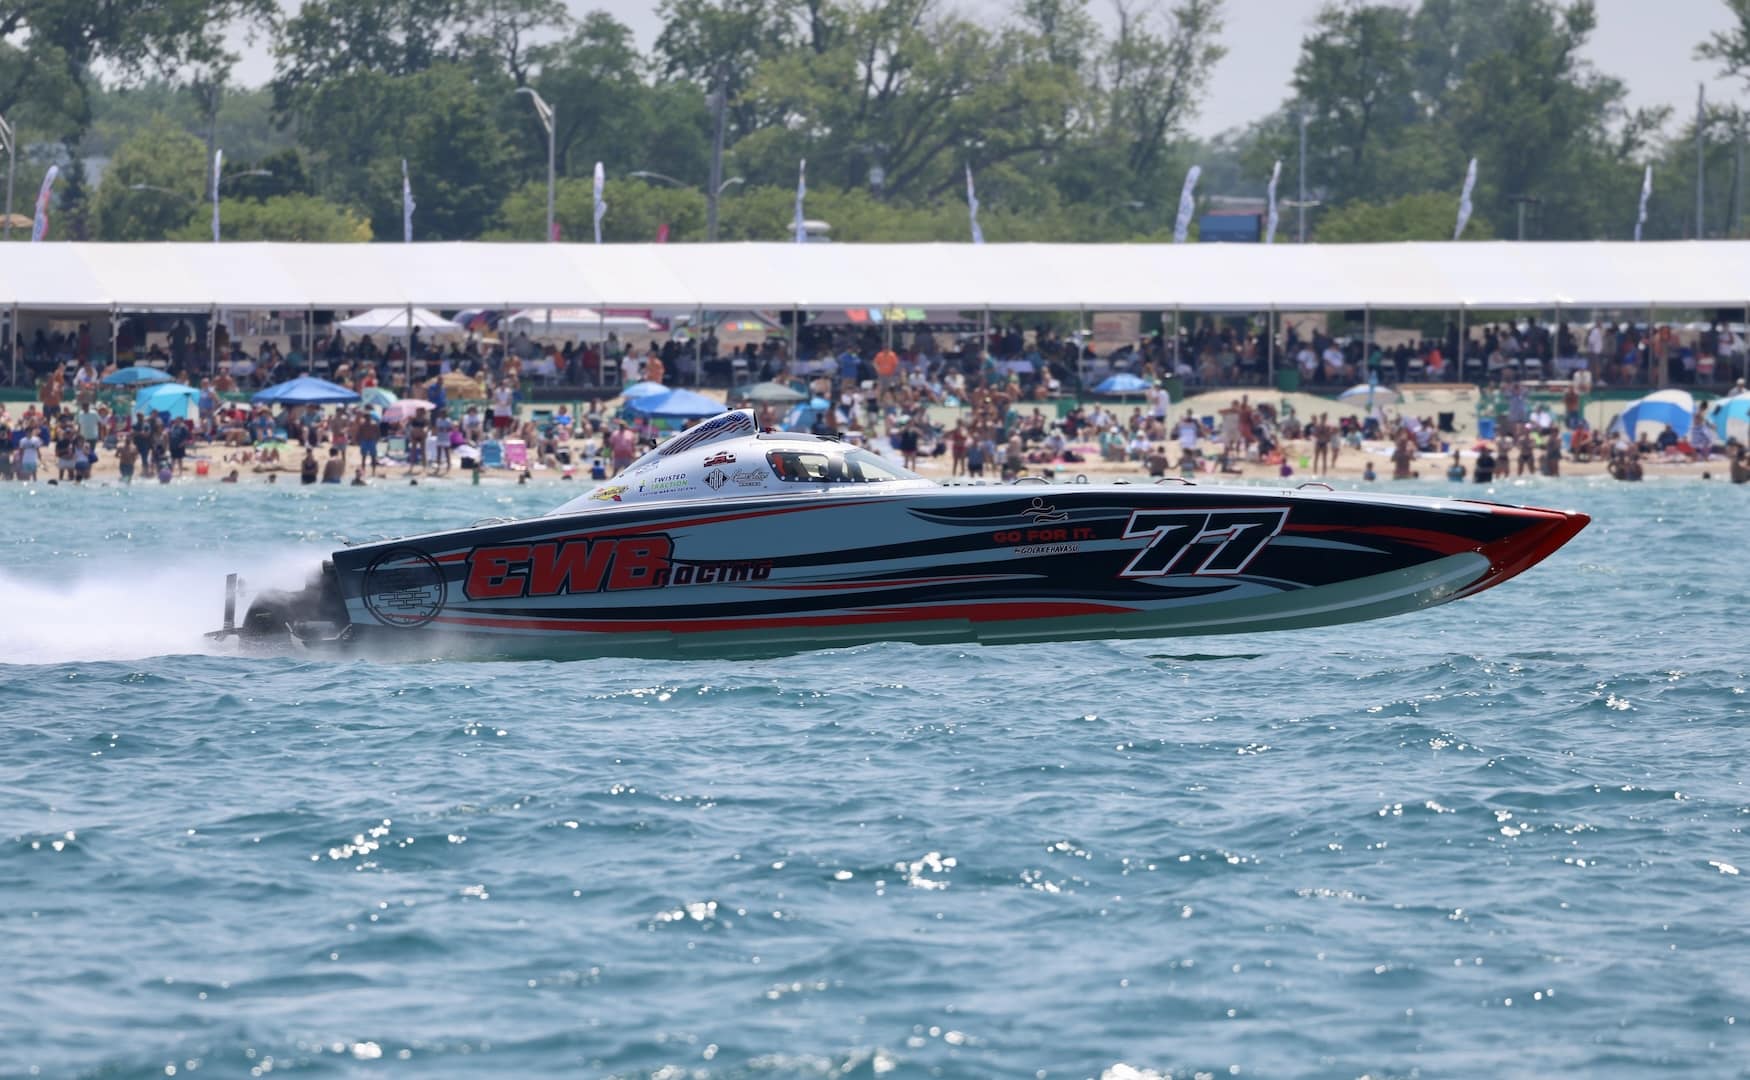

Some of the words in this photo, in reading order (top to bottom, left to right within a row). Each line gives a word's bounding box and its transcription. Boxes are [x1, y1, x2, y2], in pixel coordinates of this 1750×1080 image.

[651, 480, 689, 490] TRACTION
[654, 473, 686, 483] TWISTED
[993, 531, 1021, 544] GO
[1027, 529, 1067, 542] FOR
[1116, 506, 1293, 578] 77
[463, 533, 674, 600] EWB
[652, 560, 774, 586] RACING
